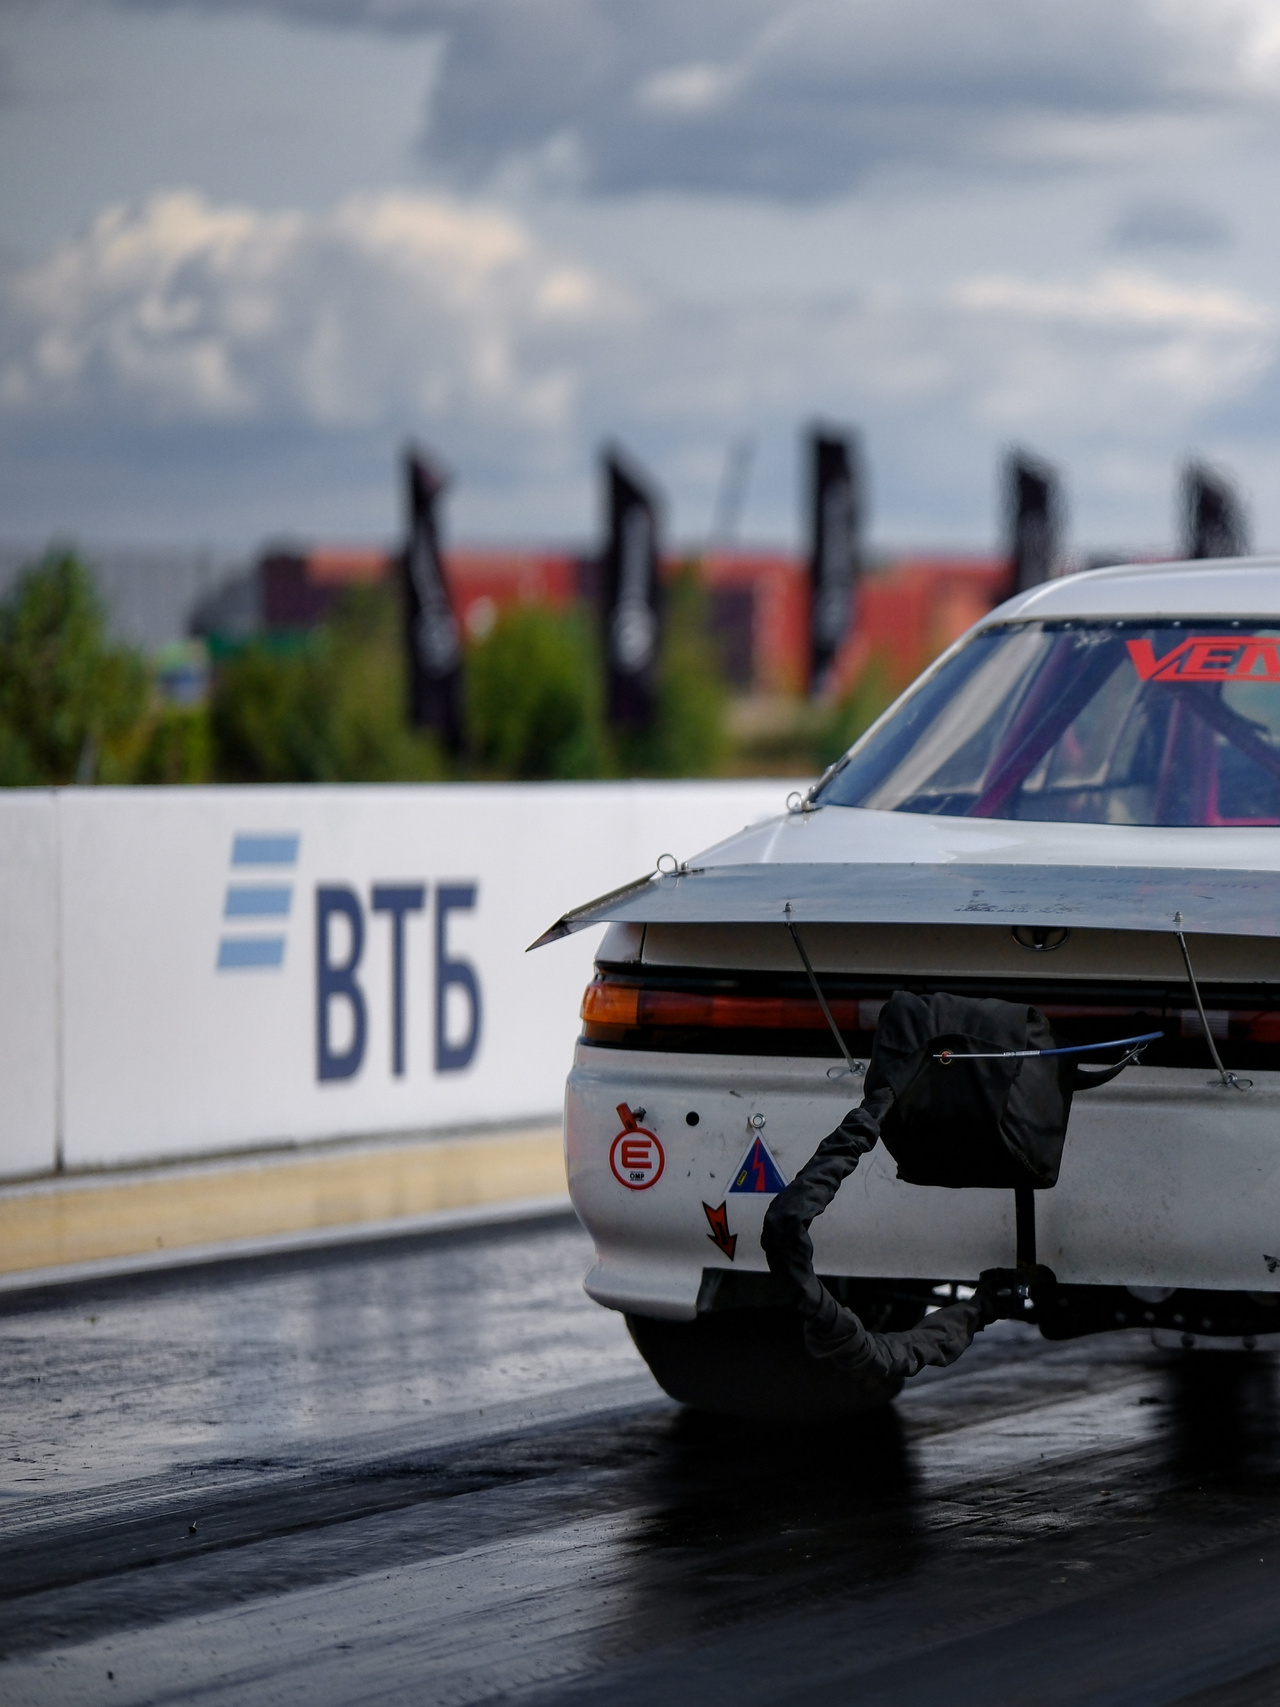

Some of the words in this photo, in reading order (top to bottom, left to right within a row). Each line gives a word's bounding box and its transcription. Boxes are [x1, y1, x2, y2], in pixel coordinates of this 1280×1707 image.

[316, 881, 483, 1081] ВТБ
[621, 1140, 652, 1169] E
[629, 1172, 645, 1180] OMP
